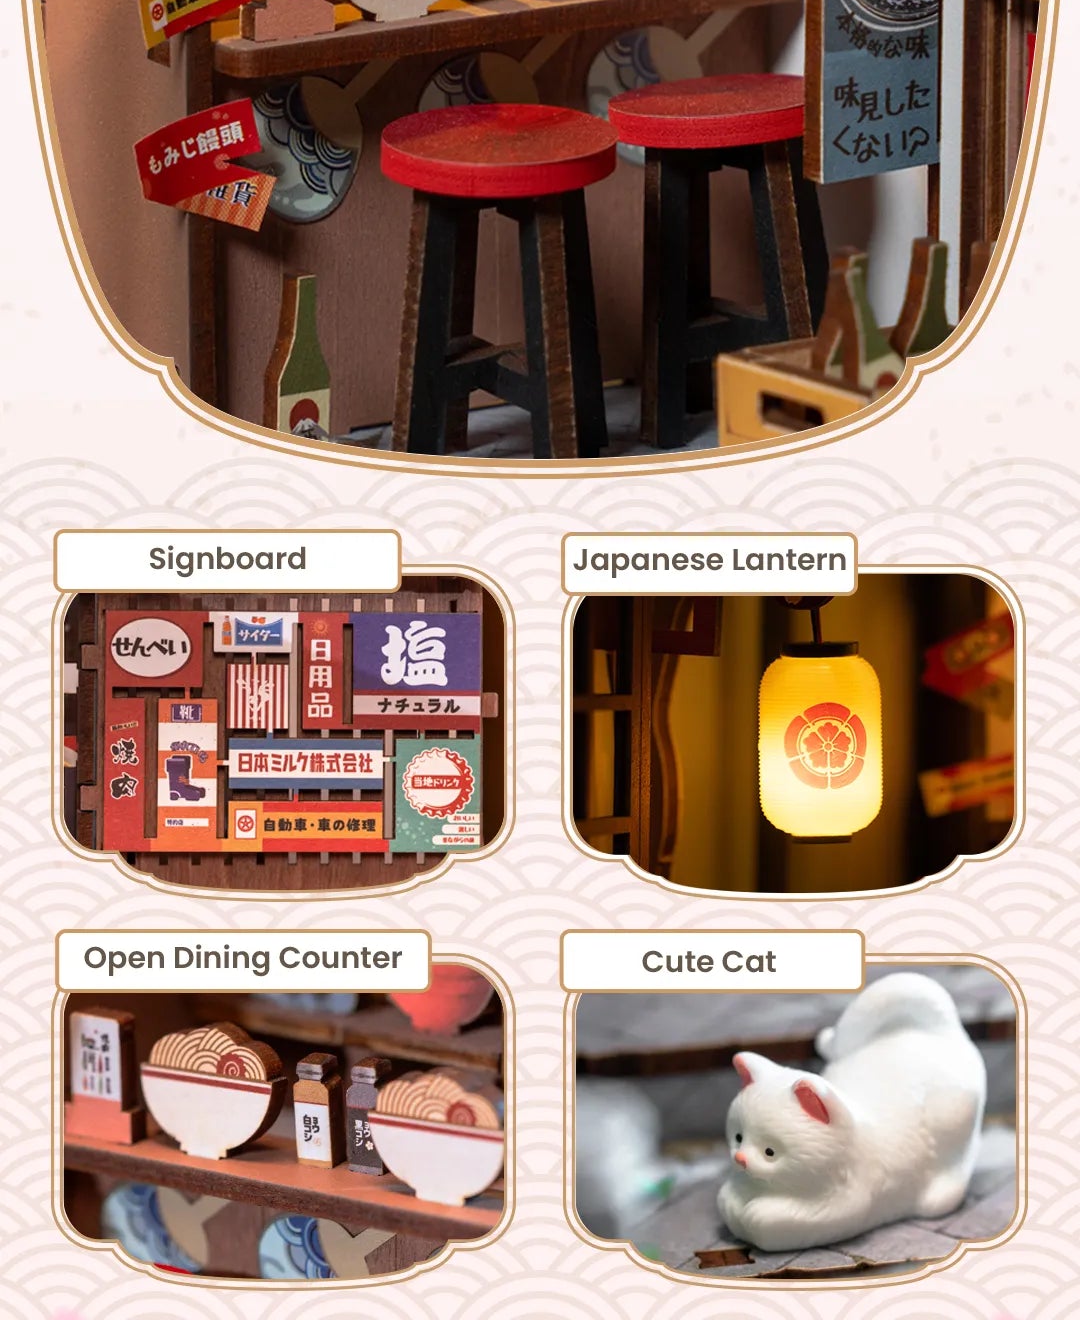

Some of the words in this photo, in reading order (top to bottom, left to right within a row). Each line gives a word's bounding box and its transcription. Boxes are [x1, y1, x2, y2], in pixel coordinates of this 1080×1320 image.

[835, 10, 931, 59] 本格的な味
[833, 76, 931, 123] 味見した
[149, 121, 245, 174] もみじ饅頭
[112, 637, 187, 657] せんべい
[238, 629, 280, 642] サイダー
[381, 620, 448, 686] 塩
[307, 639, 333, 718] 日用品
[378, 698, 460, 714] ナチュラル
[238, 752, 373, 773] 日本ミルク株式会社
[264, 818, 376, 832] 自動車・車の修理
